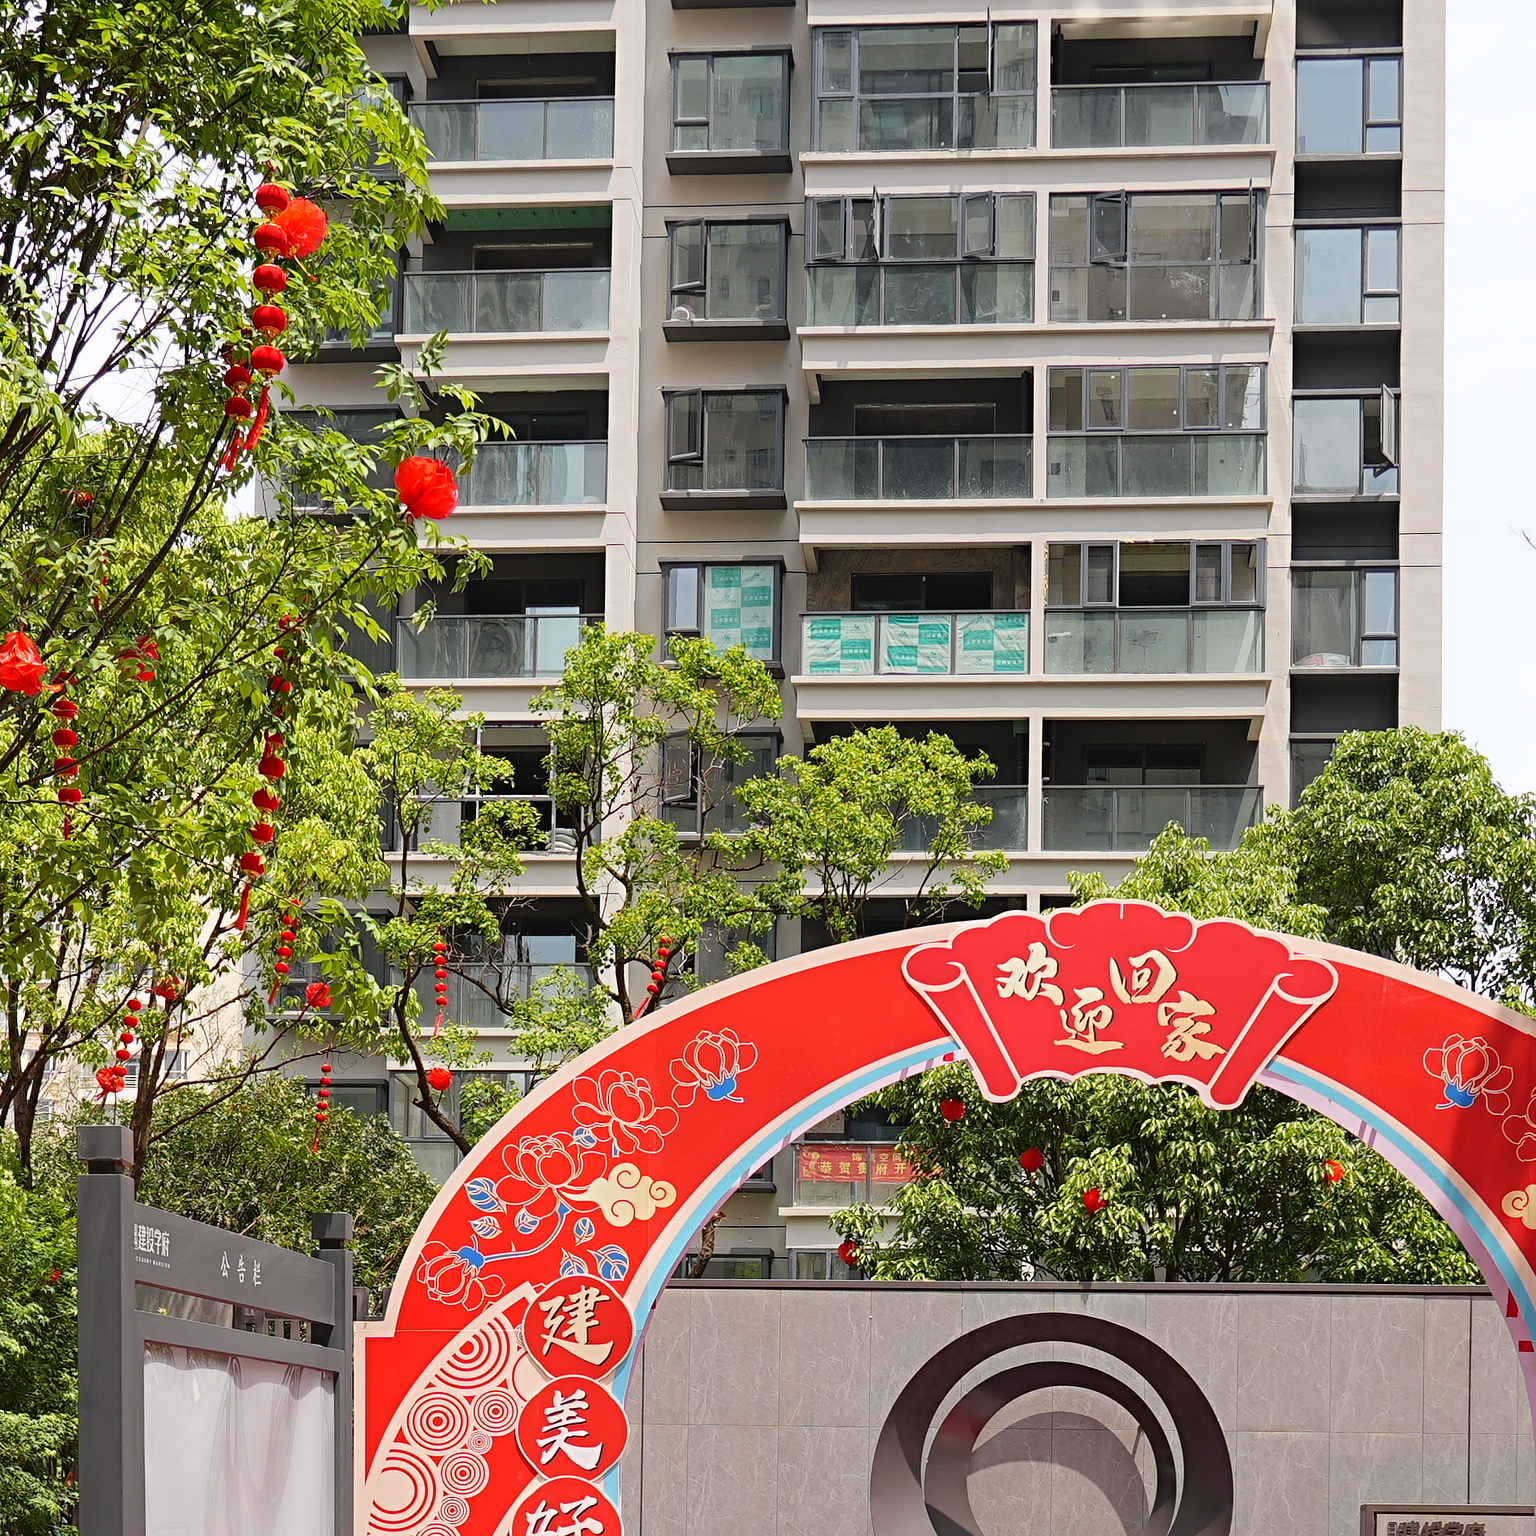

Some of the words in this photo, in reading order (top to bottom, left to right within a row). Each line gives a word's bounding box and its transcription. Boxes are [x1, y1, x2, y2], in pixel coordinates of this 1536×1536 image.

[995, 941, 1229, 1062] 欢迎回家
[138, 1224, 171, 1257] 建投学府
[220, 1250, 262, 1287] 公告栏
